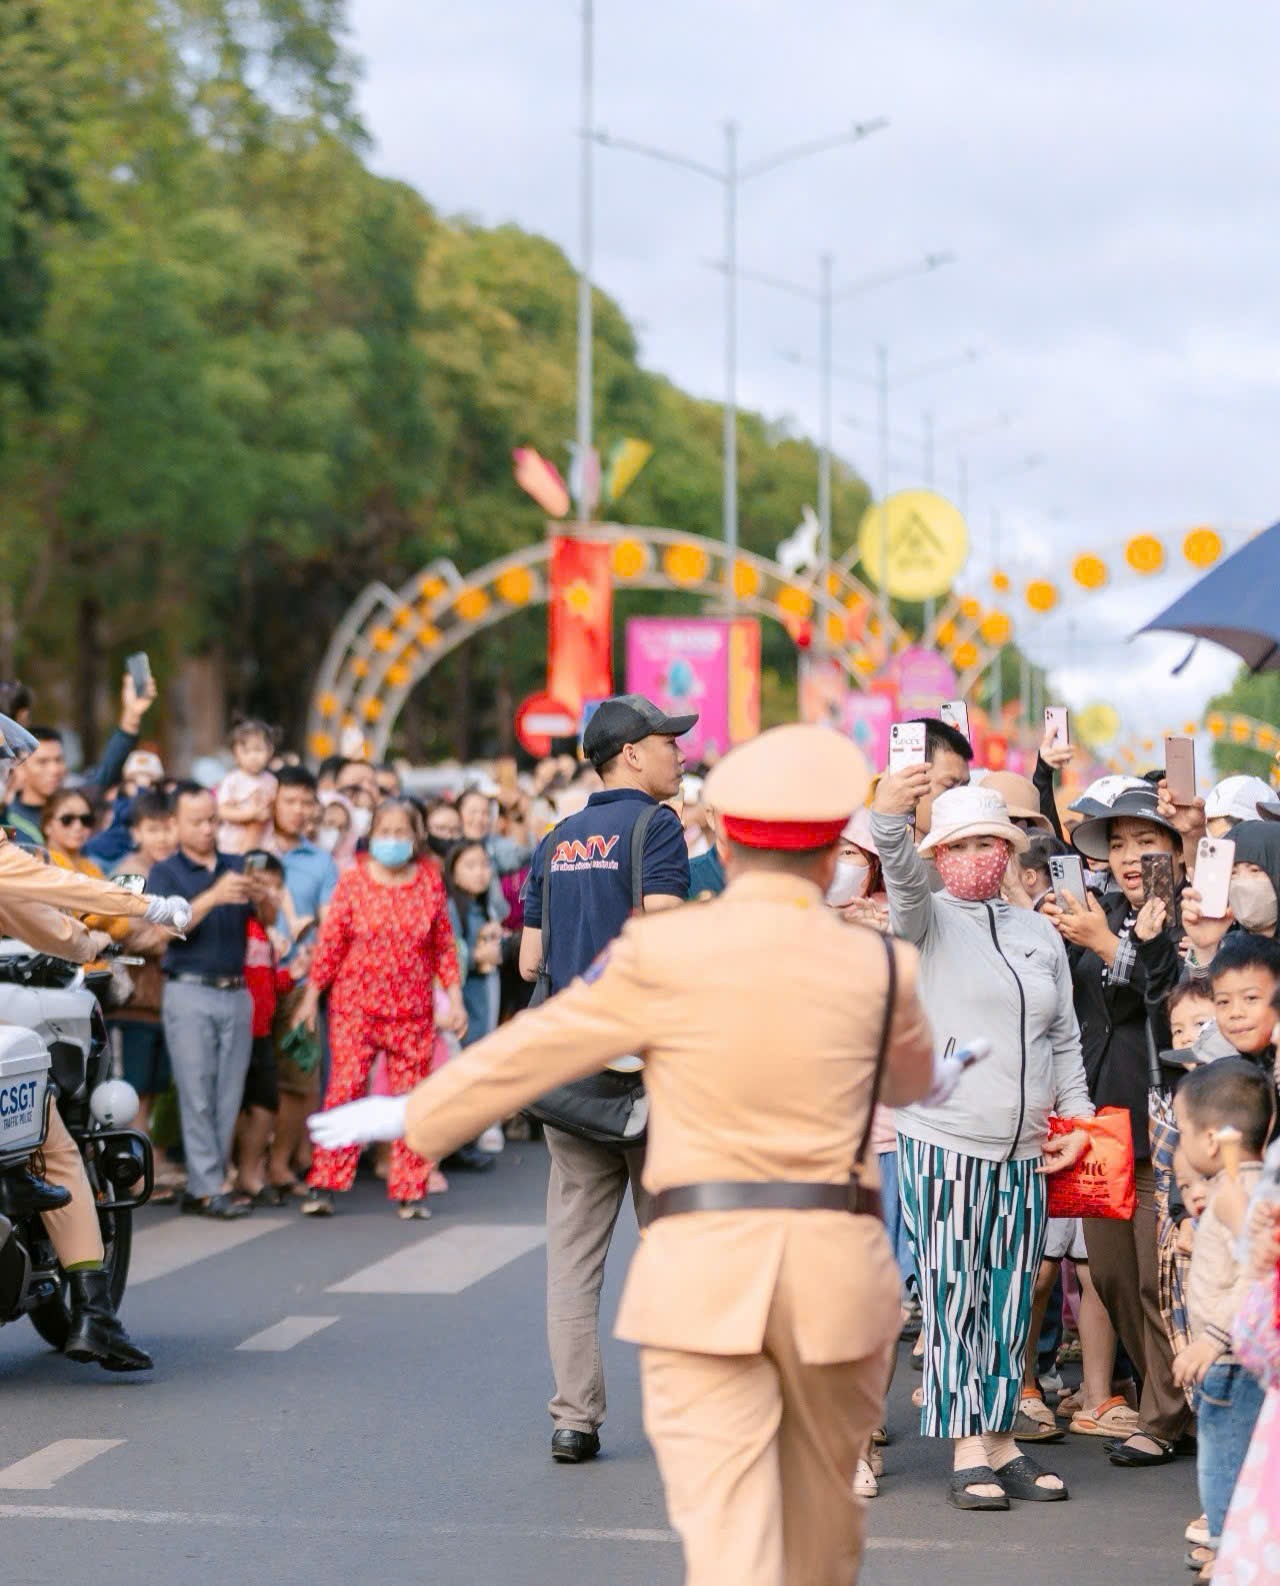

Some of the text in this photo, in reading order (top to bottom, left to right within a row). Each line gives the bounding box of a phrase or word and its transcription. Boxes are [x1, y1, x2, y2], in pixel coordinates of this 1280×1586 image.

[551, 835, 620, 863] ANTV
[3, 1111, 33, 1130] TRAFFIC POLICE
